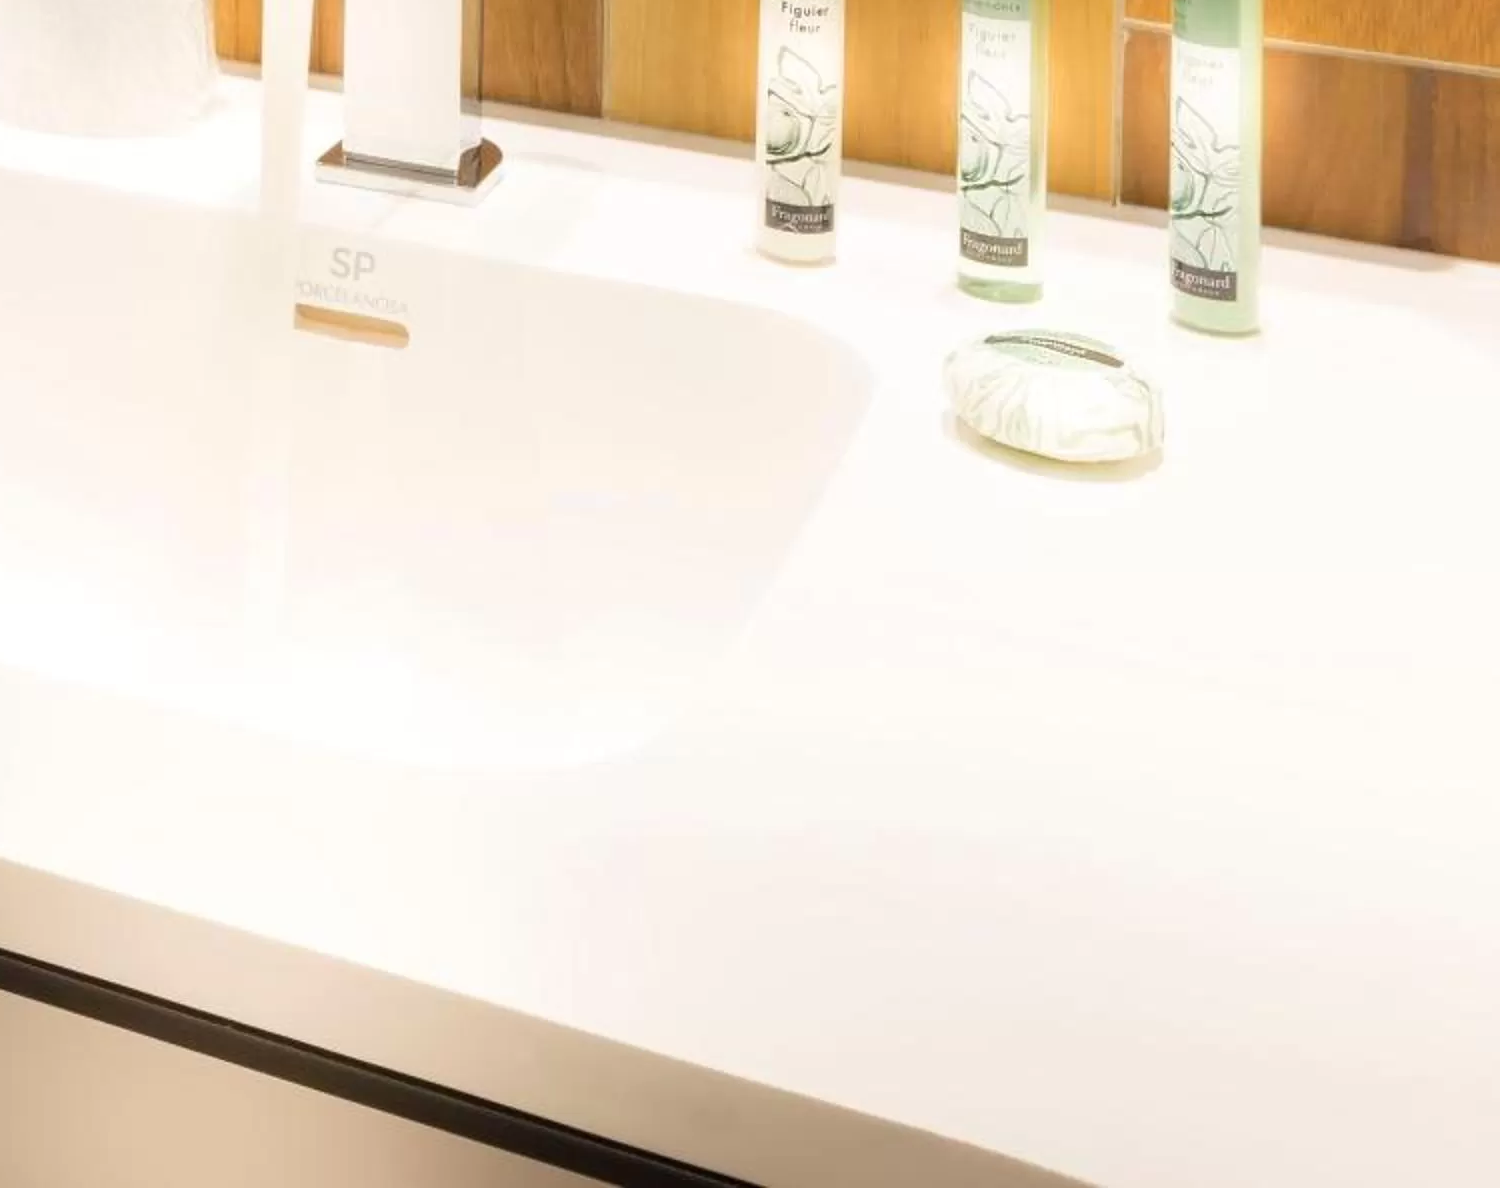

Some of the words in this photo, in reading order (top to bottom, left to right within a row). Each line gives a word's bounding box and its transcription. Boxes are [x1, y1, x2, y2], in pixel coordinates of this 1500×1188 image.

[781, 1, 830, 19] Figuier
[789, 18, 821, 33] fleur
[329, 246, 376, 280] SP
